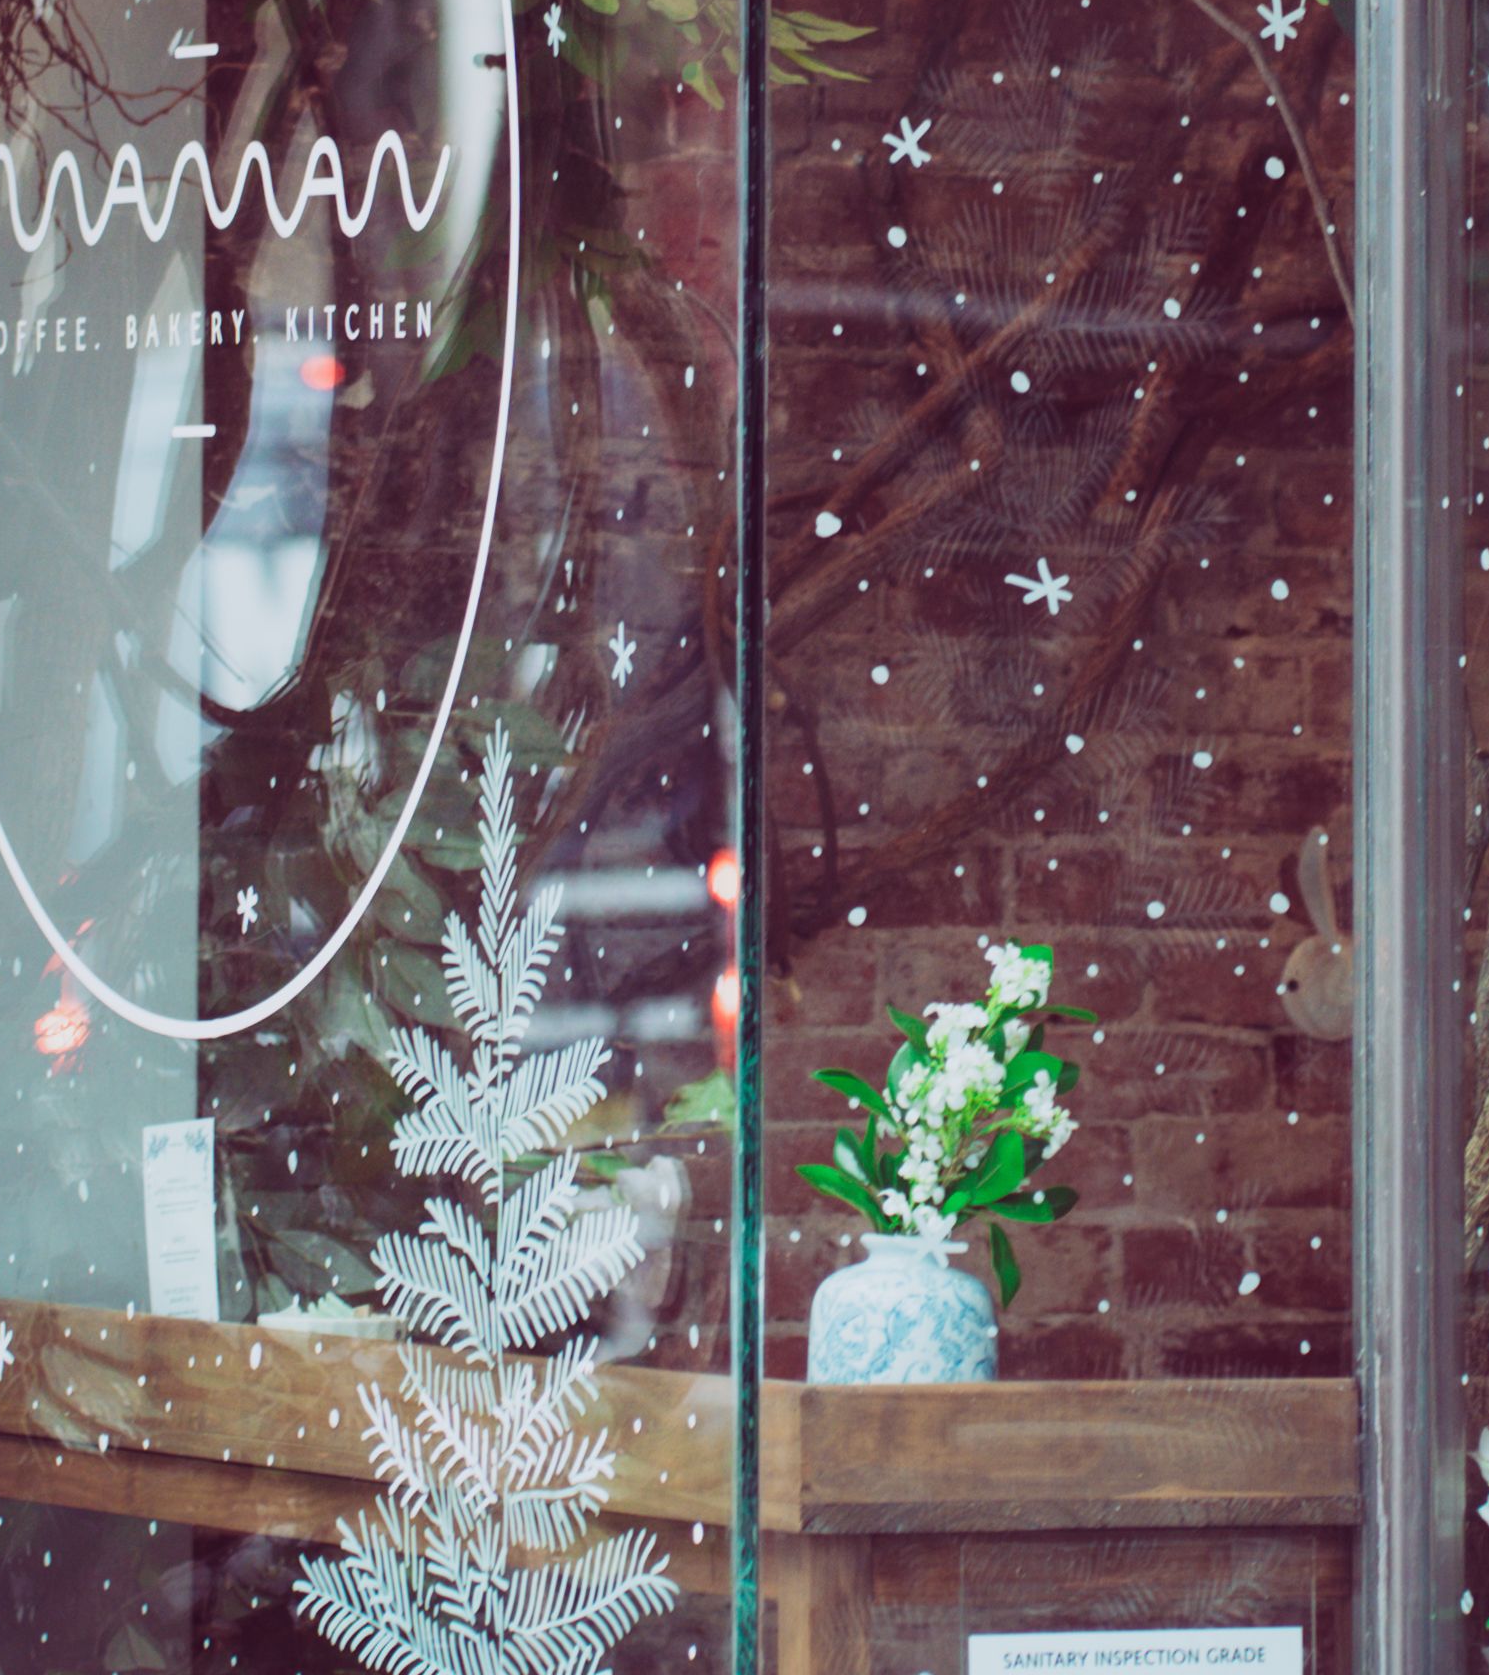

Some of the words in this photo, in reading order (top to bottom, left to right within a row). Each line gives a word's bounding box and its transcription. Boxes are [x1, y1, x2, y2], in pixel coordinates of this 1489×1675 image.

[285, 300, 433, 342] KITCHEN
[1003, 1651, 1089, 1670] SANITARY
[1094, 1648, 1200, 1667] INSPECTION
[1206, 1646, 1266, 1664] GRADE
